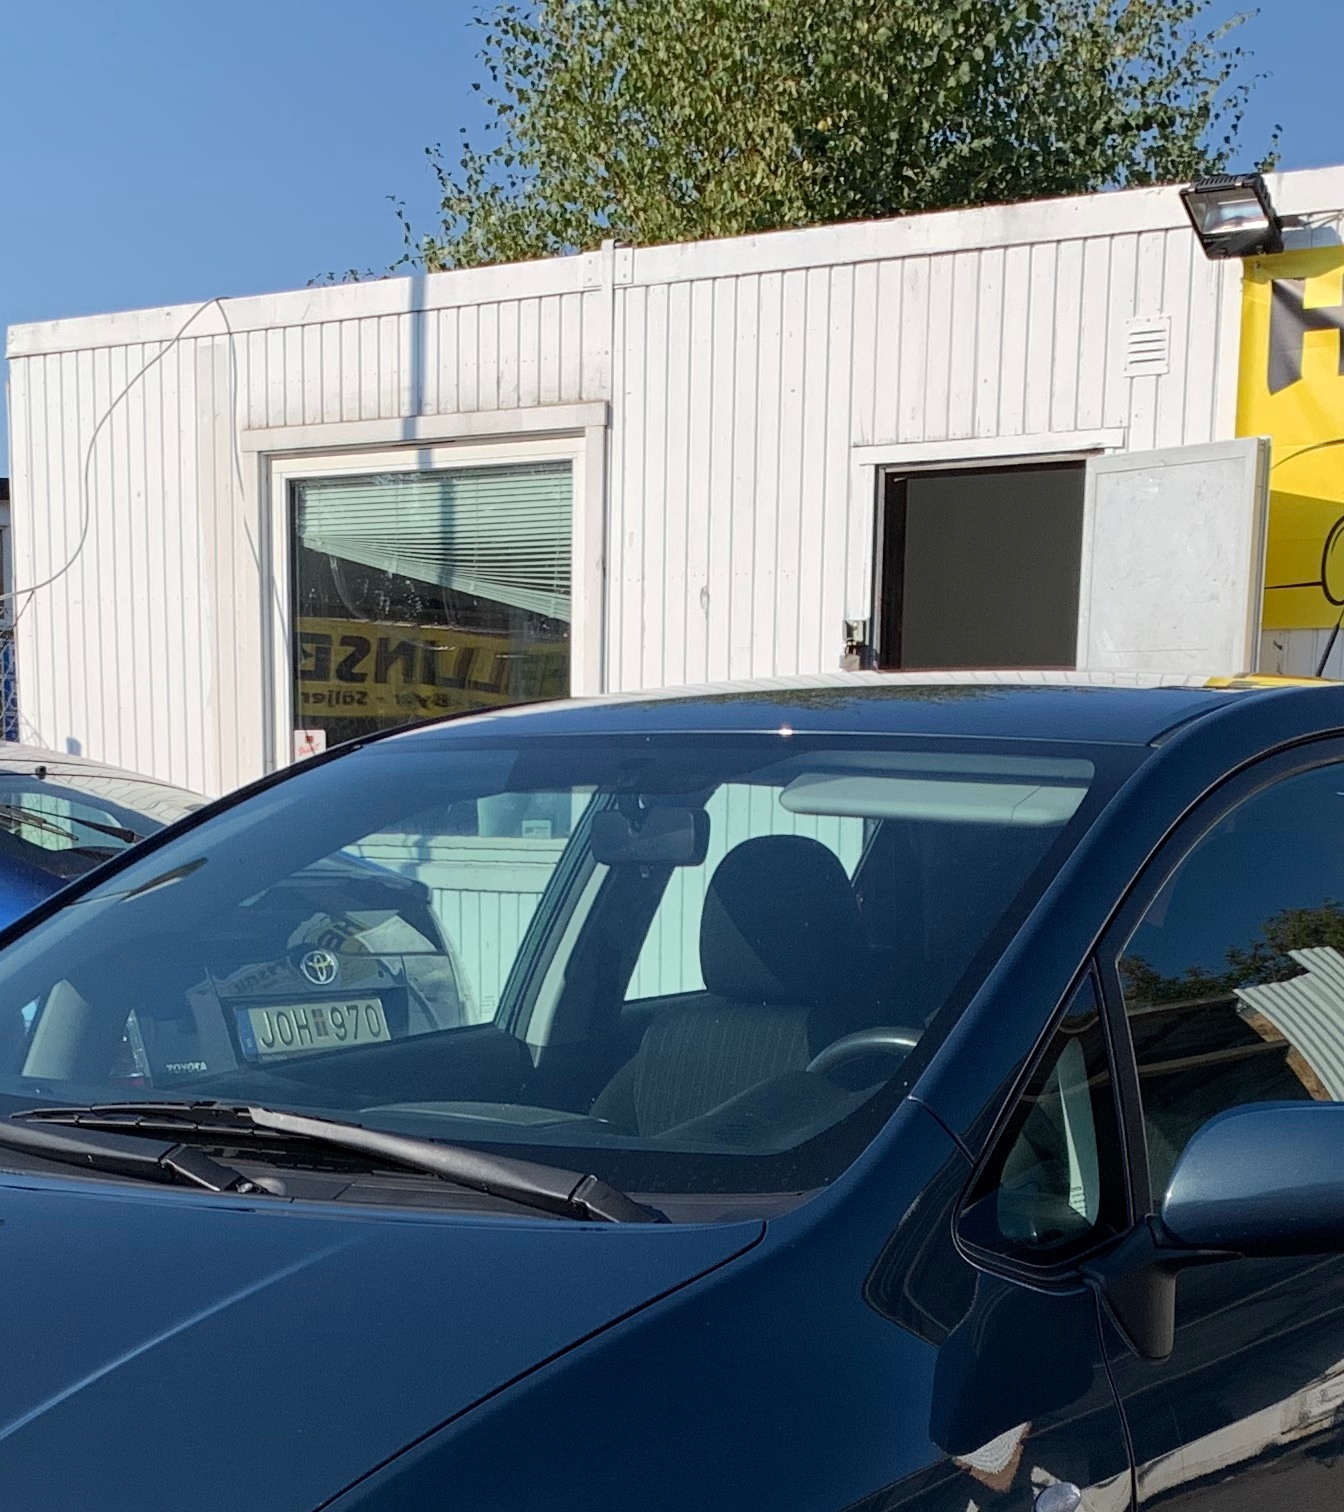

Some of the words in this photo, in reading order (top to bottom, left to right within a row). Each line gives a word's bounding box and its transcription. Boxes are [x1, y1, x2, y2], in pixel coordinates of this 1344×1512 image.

[259, 1009, 314, 1048] JOH
[329, 1003, 382, 1041] 970
[165, 1061, 208, 1073] TOYOTA
